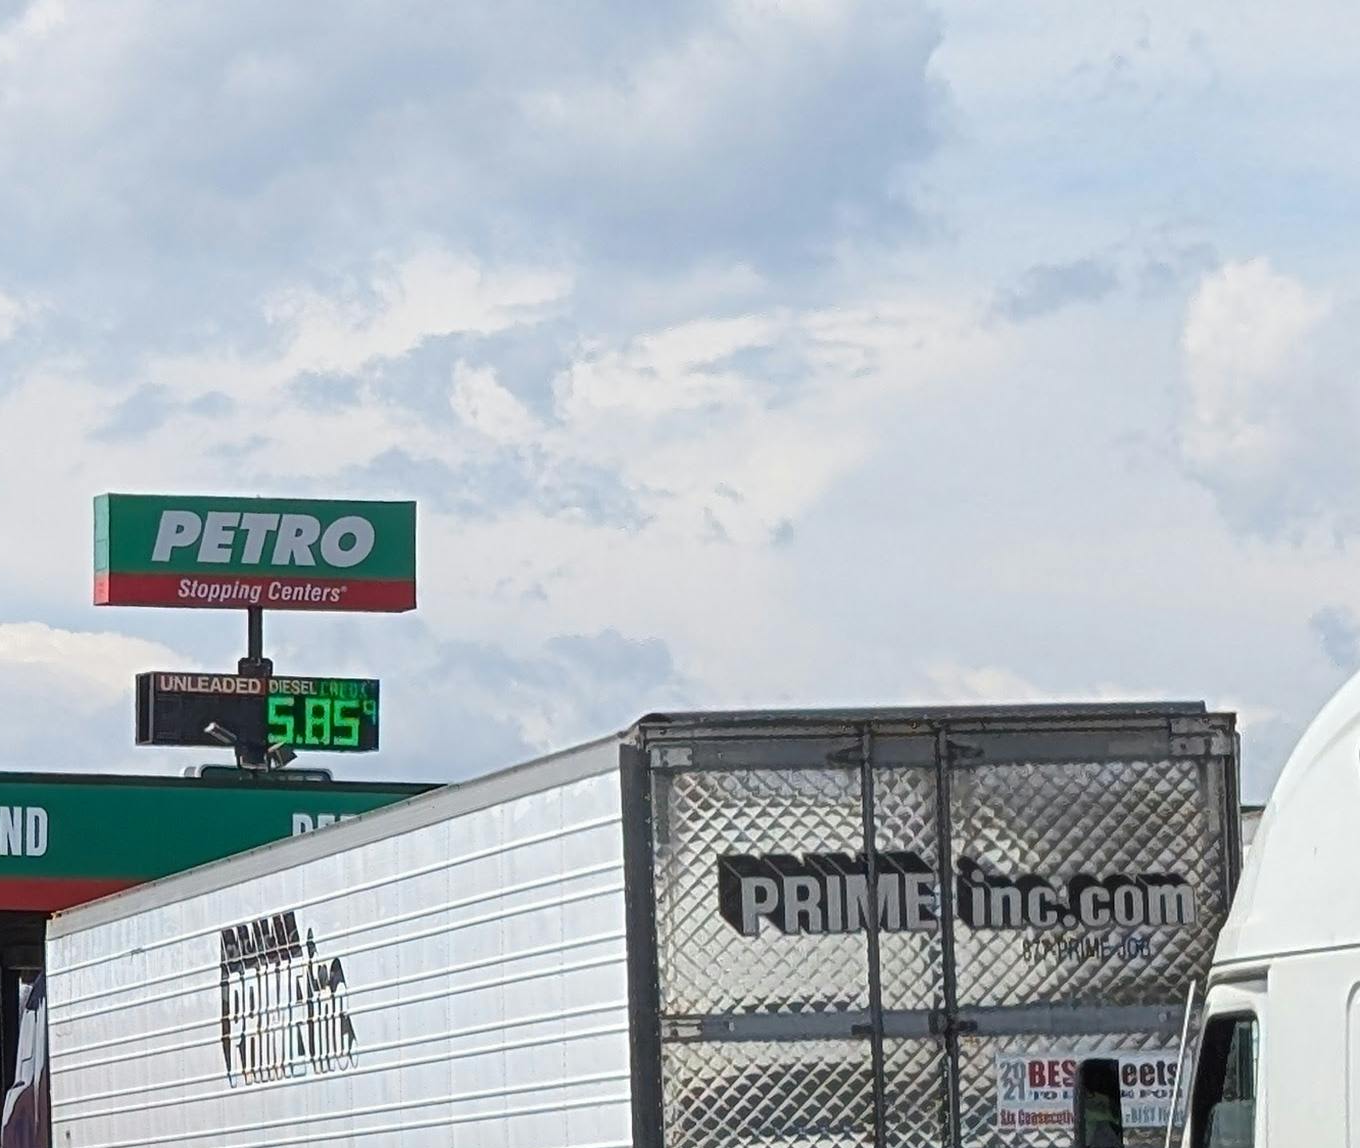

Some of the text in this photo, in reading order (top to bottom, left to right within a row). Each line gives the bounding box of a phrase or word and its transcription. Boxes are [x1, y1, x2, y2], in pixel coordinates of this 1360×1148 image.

[151, 510, 376, 568] PETRO
[178, 578, 262, 604] Stopping
[160, 675, 262, 694] UNLEADED
[268, 679, 318, 696] DIESEL
[720, 854, 938, 936] PRIME
[1028, 1060, 1077, 1088] BES
